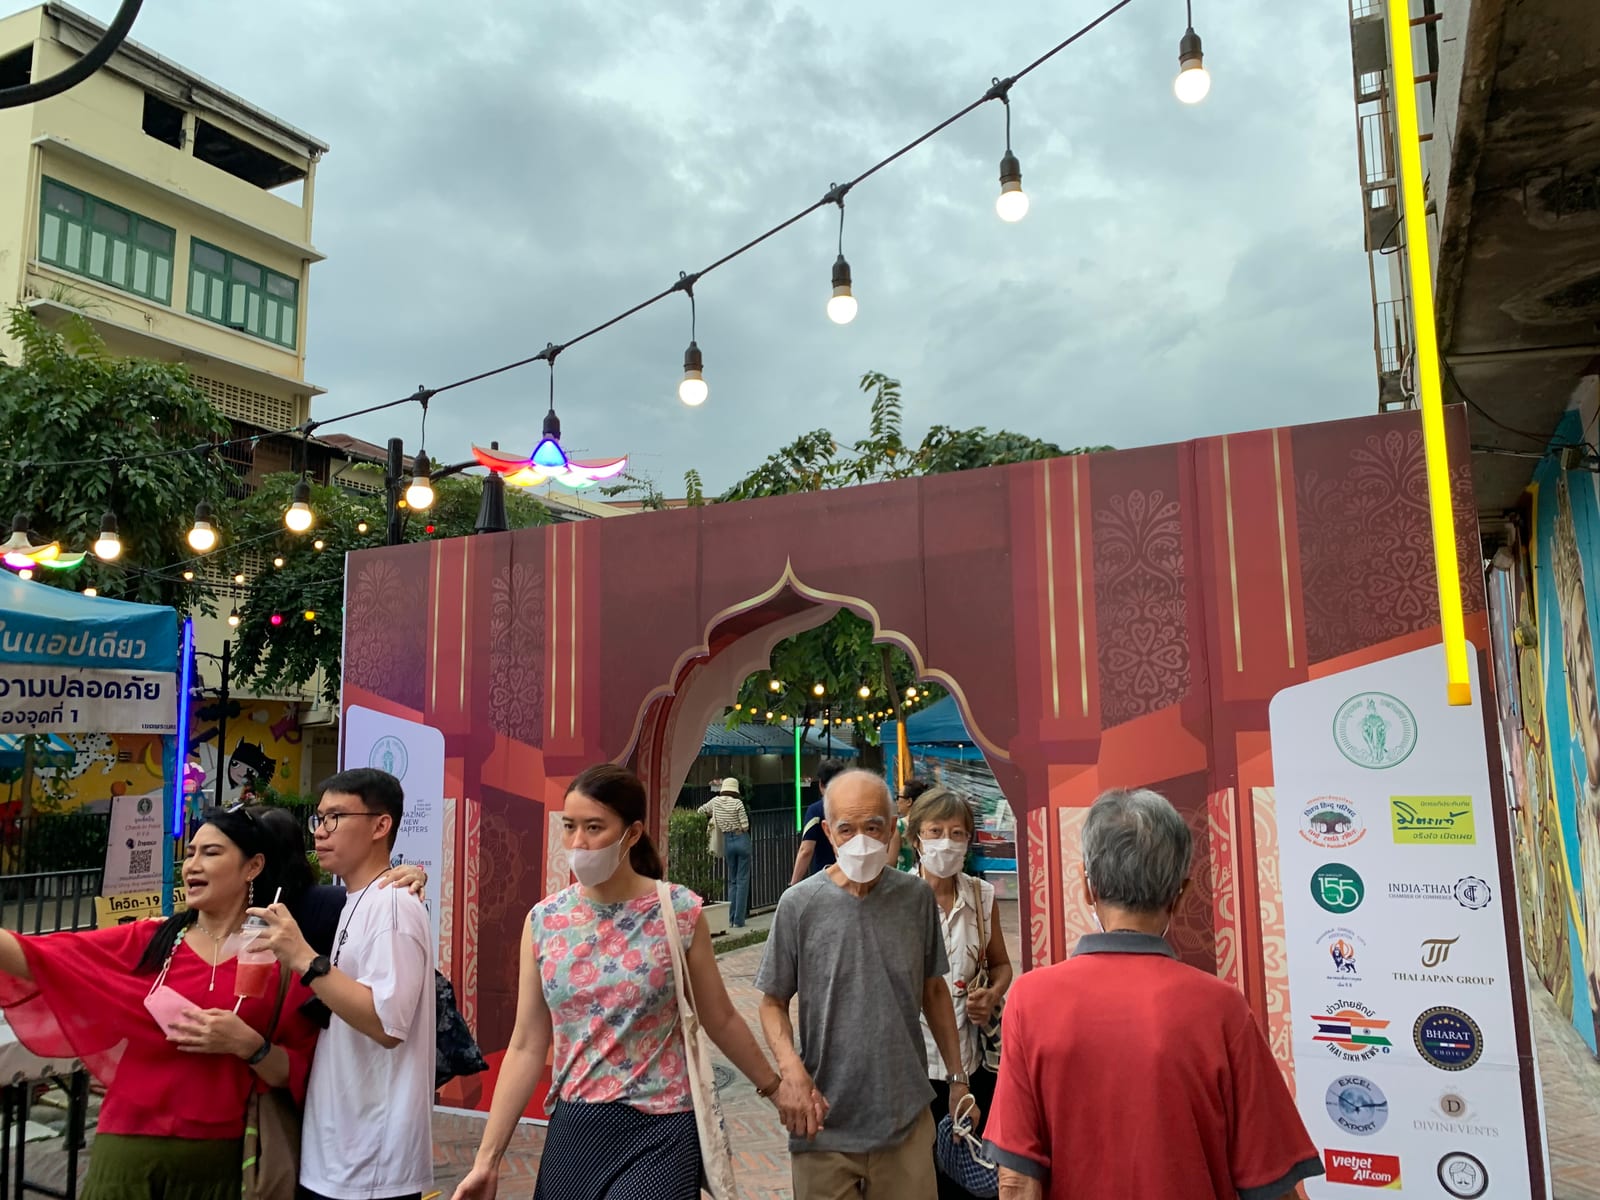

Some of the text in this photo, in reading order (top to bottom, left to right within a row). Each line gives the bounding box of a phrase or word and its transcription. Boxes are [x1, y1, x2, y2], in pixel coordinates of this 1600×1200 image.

[70, 709, 79, 723] 1
[399, 826, 429, 834] HAPTERS
[1318, 877, 1359, 908] 155
[1388, 882, 1452, 894] INDIA-THAI
[1392, 972, 1495, 986] THAI JAPAN GROUP
[1426, 1029, 1471, 1041] BHARAT
[1326, 1042, 1380, 1062] THAI SIKH NEWS
[1338, 1078, 1372, 1091] EXCEL
[1446, 1099, 1461, 1113] D
[1338, 1116, 1376, 1132] EXPORT
